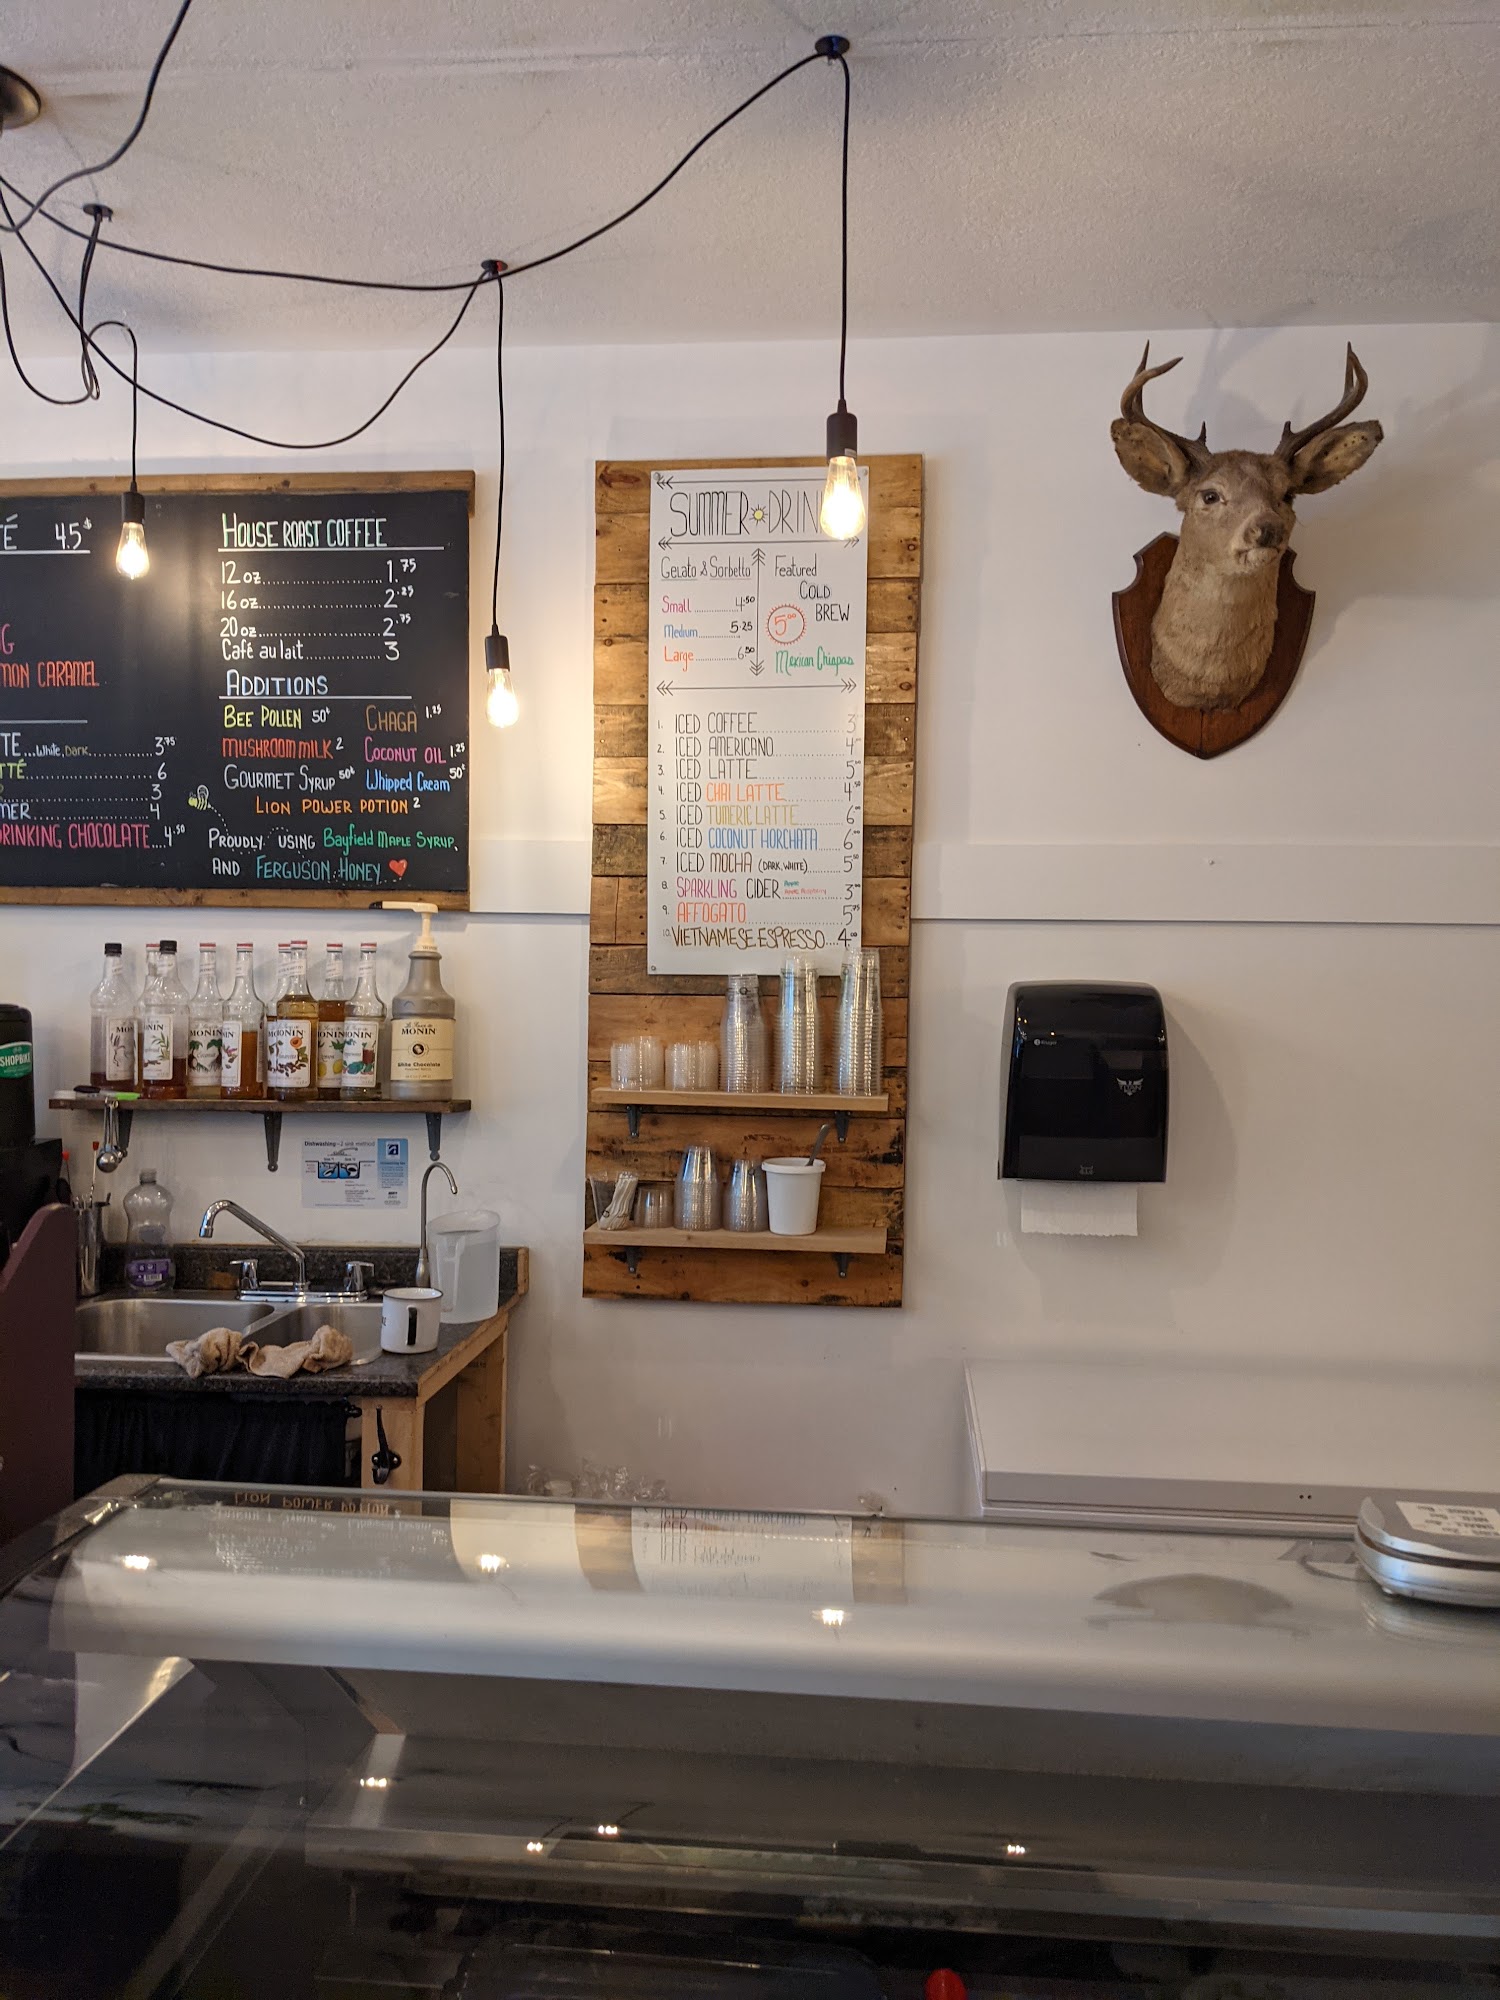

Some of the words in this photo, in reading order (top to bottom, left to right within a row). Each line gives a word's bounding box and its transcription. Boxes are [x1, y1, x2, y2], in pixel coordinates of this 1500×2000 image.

[670, 490, 750, 537] SUMMER
[222, 512, 278, 548] HOUSE
[283, 520, 322, 548] ROAST
[327, 518, 387, 547] COFFEE
[221, 561, 241, 584] 12
[243, 571, 261, 584] oz
[661, 556, 697, 579] Gelato
[700, 561, 708, 576] &
[709, 555, 751, 578] Sorbetto
[774, 553, 817, 577] Featured
[221, 590, 237, 609] 16
[240, 597, 259, 609] oz
[800, 580, 831, 600] COLD
[662, 596, 692, 613] Small
[815, 603, 850, 621] BREW
[219, 616, 238, 637] 20
[241, 626, 257, 637] oz
[663, 624, 698, 638] Medium
[222, 638, 253, 661] Café
[259, 644, 276, 659] au
[280, 639, 303, 660] lait
[384, 641, 400, 661] 3
[664, 646, 694, 672] Large
[775, 650, 814, 676] Mexican
[817, 646, 854, 676] Chiapas
[37, 660, 98, 687] CARAMEL
[226, 668, 329, 696] ADDITIONS
[224, 704, 254, 729] BEE
[261, 705, 302, 729] POLLEN
[365, 704, 418, 733] CHAGA
[675, 714, 701, 734] ICED
[707, 712, 758, 733] COFFEE
[221, 737, 296, 759] MUSHROOM
[298, 738, 334, 759] MILK
[336, 736, 344, 750] 2
[364, 736, 417, 763] COCONUT
[424, 747, 446, 764] OIL
[675, 737, 701, 757] ICED
[708, 736, 774, 757] AMERICANO
[157, 762, 167, 780] 6
[223, 763, 295, 790] GOURMET
[298, 765, 336, 793] SYRUP
[365, 768, 412, 792] Whipped
[675, 759, 701, 779] ICED
[709, 759, 758, 779] LATTE
[152, 784, 162, 800] 3
[676, 782, 702, 802] ICED
[706, 782, 732, 802] CHAI
[736, 783, 785, 801] LATTE
[150, 803, 160, 820] 4
[256, 796, 291, 814] LION
[302, 799, 353, 813] POWER
[360, 799, 408, 814] POTION
[413, 797, 421, 808] 2
[676, 805, 703, 825] ICED
[706, 805, 752, 825] TUMERIC
[755, 805, 800, 825] LATTE
[68, 823, 150, 848] CHOCOLATE
[208, 827, 263, 849] PROUDLY
[278, 834, 316, 850] USING
[323, 823, 374, 855] Bayfield
[377, 831, 412, 848] MAPLE
[676, 827, 703, 848] ICED
[708, 828, 757, 849] COCONUT
[760, 828, 818, 850] HORCHATA
[212, 858, 241, 877] AND
[256, 854, 330, 880] FERGUSON
[339, 857, 381, 884] HONEY
[676, 852, 704, 873] ICED
[710, 851, 753, 873] MOCHA
[676, 876, 737, 899] SPARKLING
[746, 878, 781, 899] CIDER
[677, 902, 746, 923] AFFOGATO
[672, 924, 757, 950] VIETNAMESE
[758, 926, 825, 949] ESPRESSO
